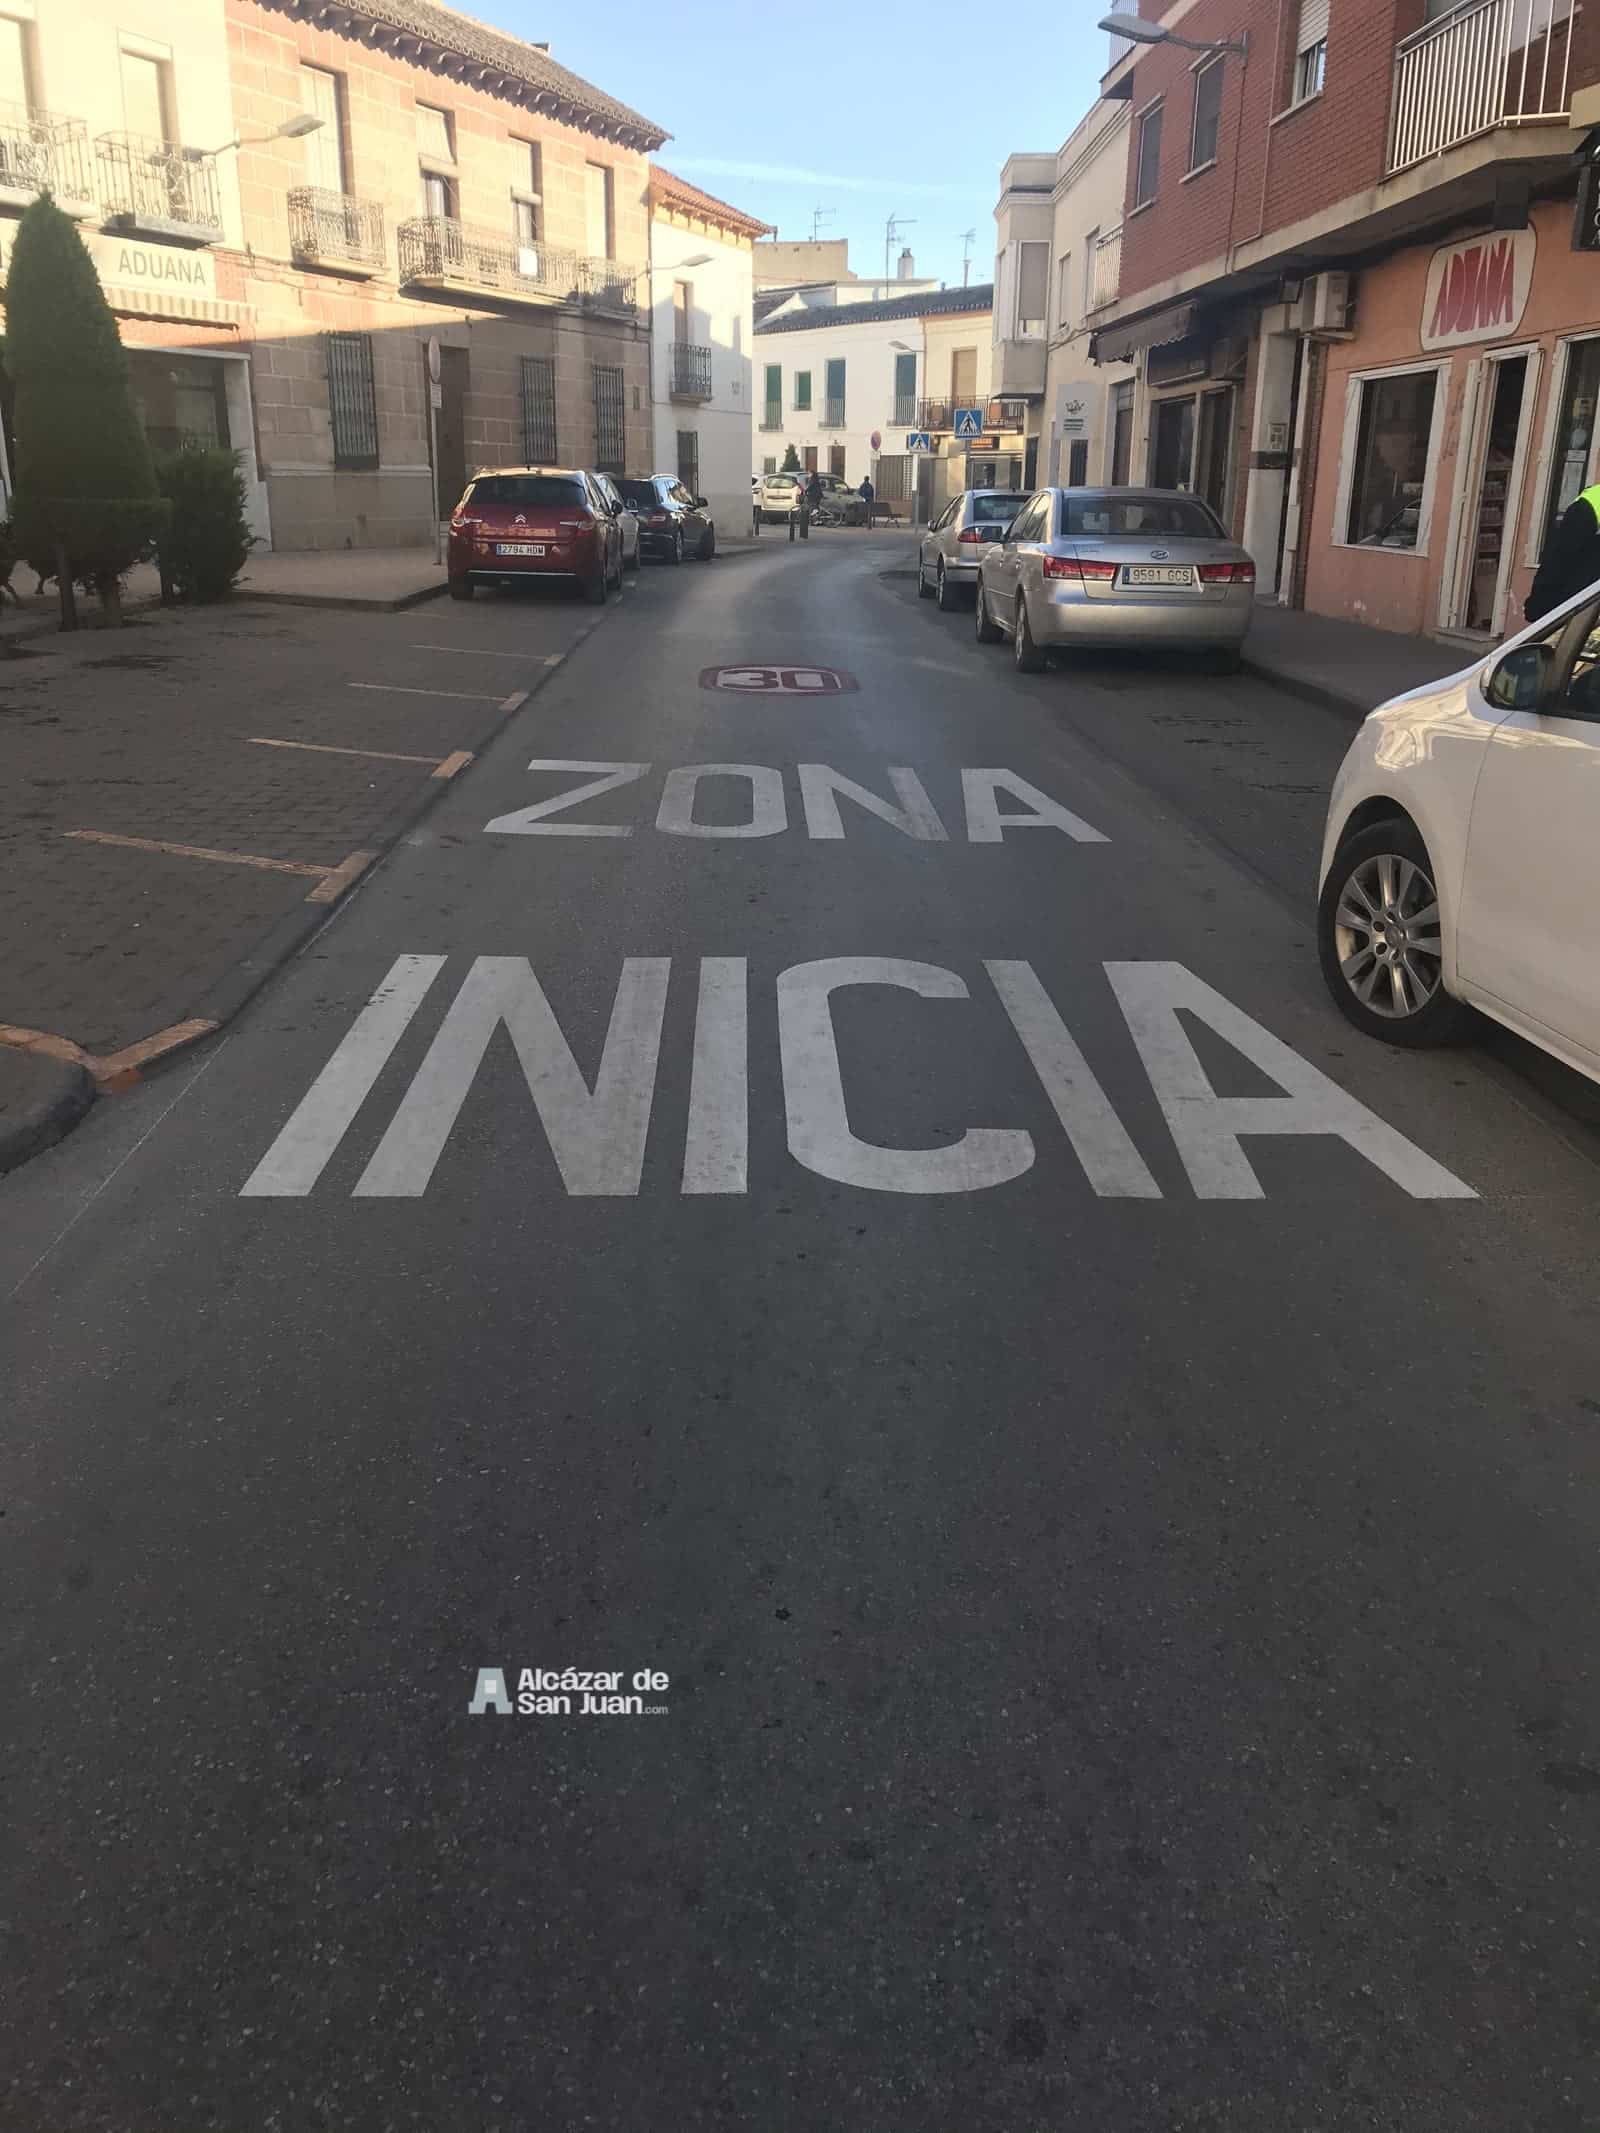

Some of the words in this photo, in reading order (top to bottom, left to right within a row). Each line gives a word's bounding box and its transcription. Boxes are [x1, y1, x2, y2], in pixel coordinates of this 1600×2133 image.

[118, 247, 206, 285] ADUANA
[1428, 237, 1515, 338] ADUANA
[1133, 569, 1161, 582] 9591
[1168, 570, 1190, 582] GCS
[721, 669, 836, 690] 30
[483, 759, 1112, 843] ZONA
[238, 954, 1481, 1200] INICIA
